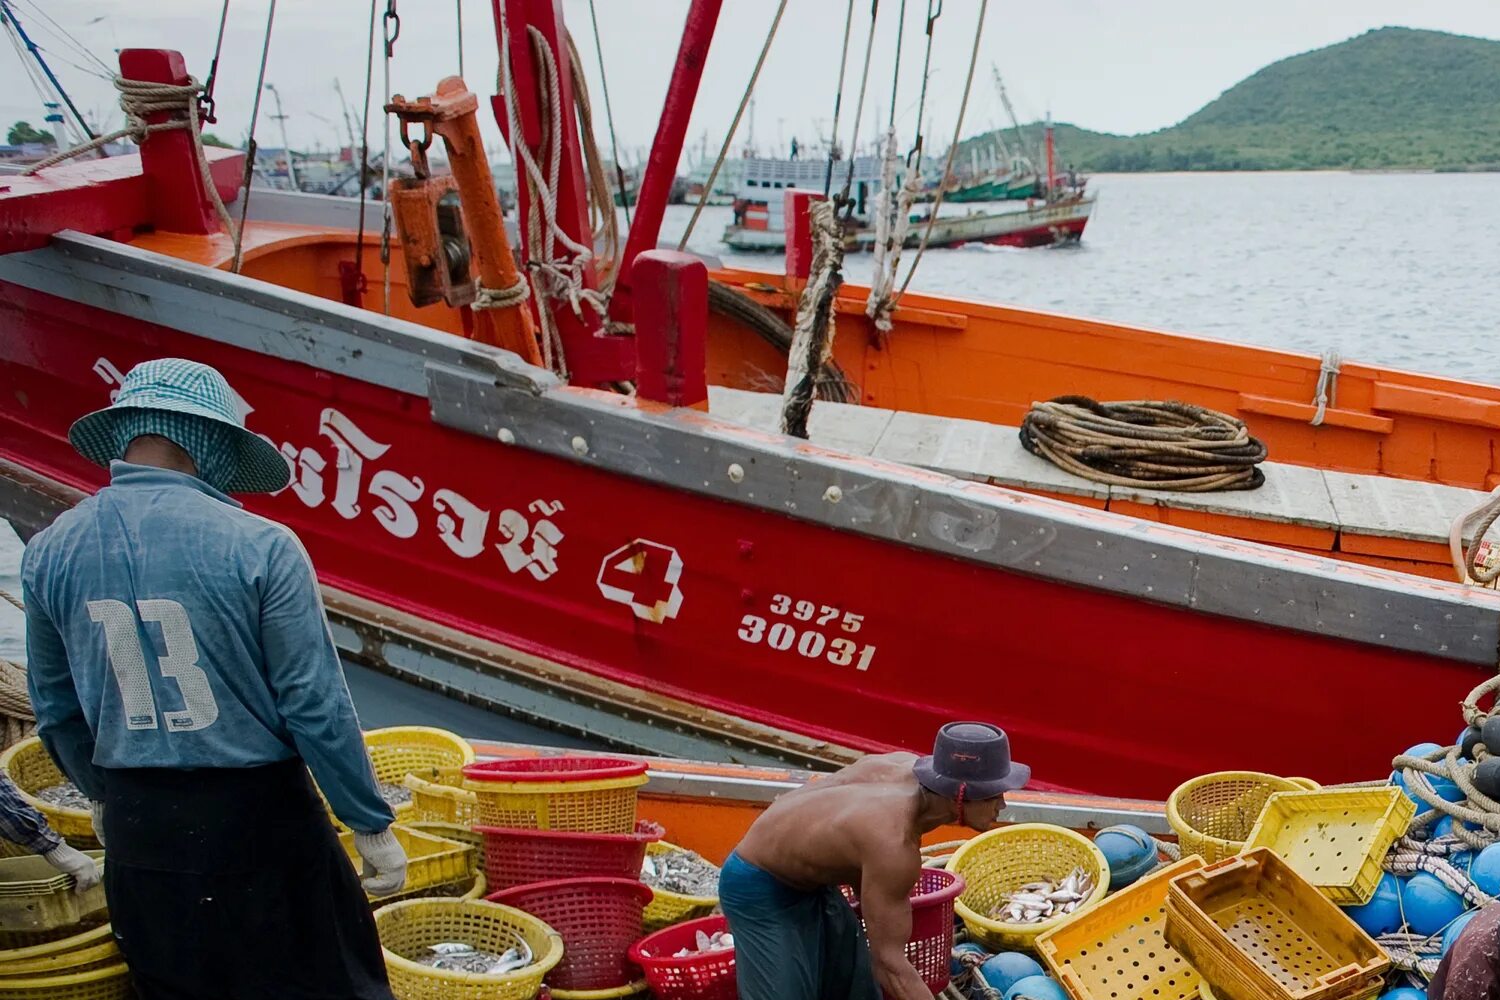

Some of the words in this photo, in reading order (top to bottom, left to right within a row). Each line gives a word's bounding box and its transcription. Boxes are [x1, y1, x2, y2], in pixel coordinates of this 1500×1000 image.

[597, 538, 684, 624] 4
[770, 594, 865, 633] 3975
[87, 599, 219, 732] 13
[738, 614, 877, 671] 30031
